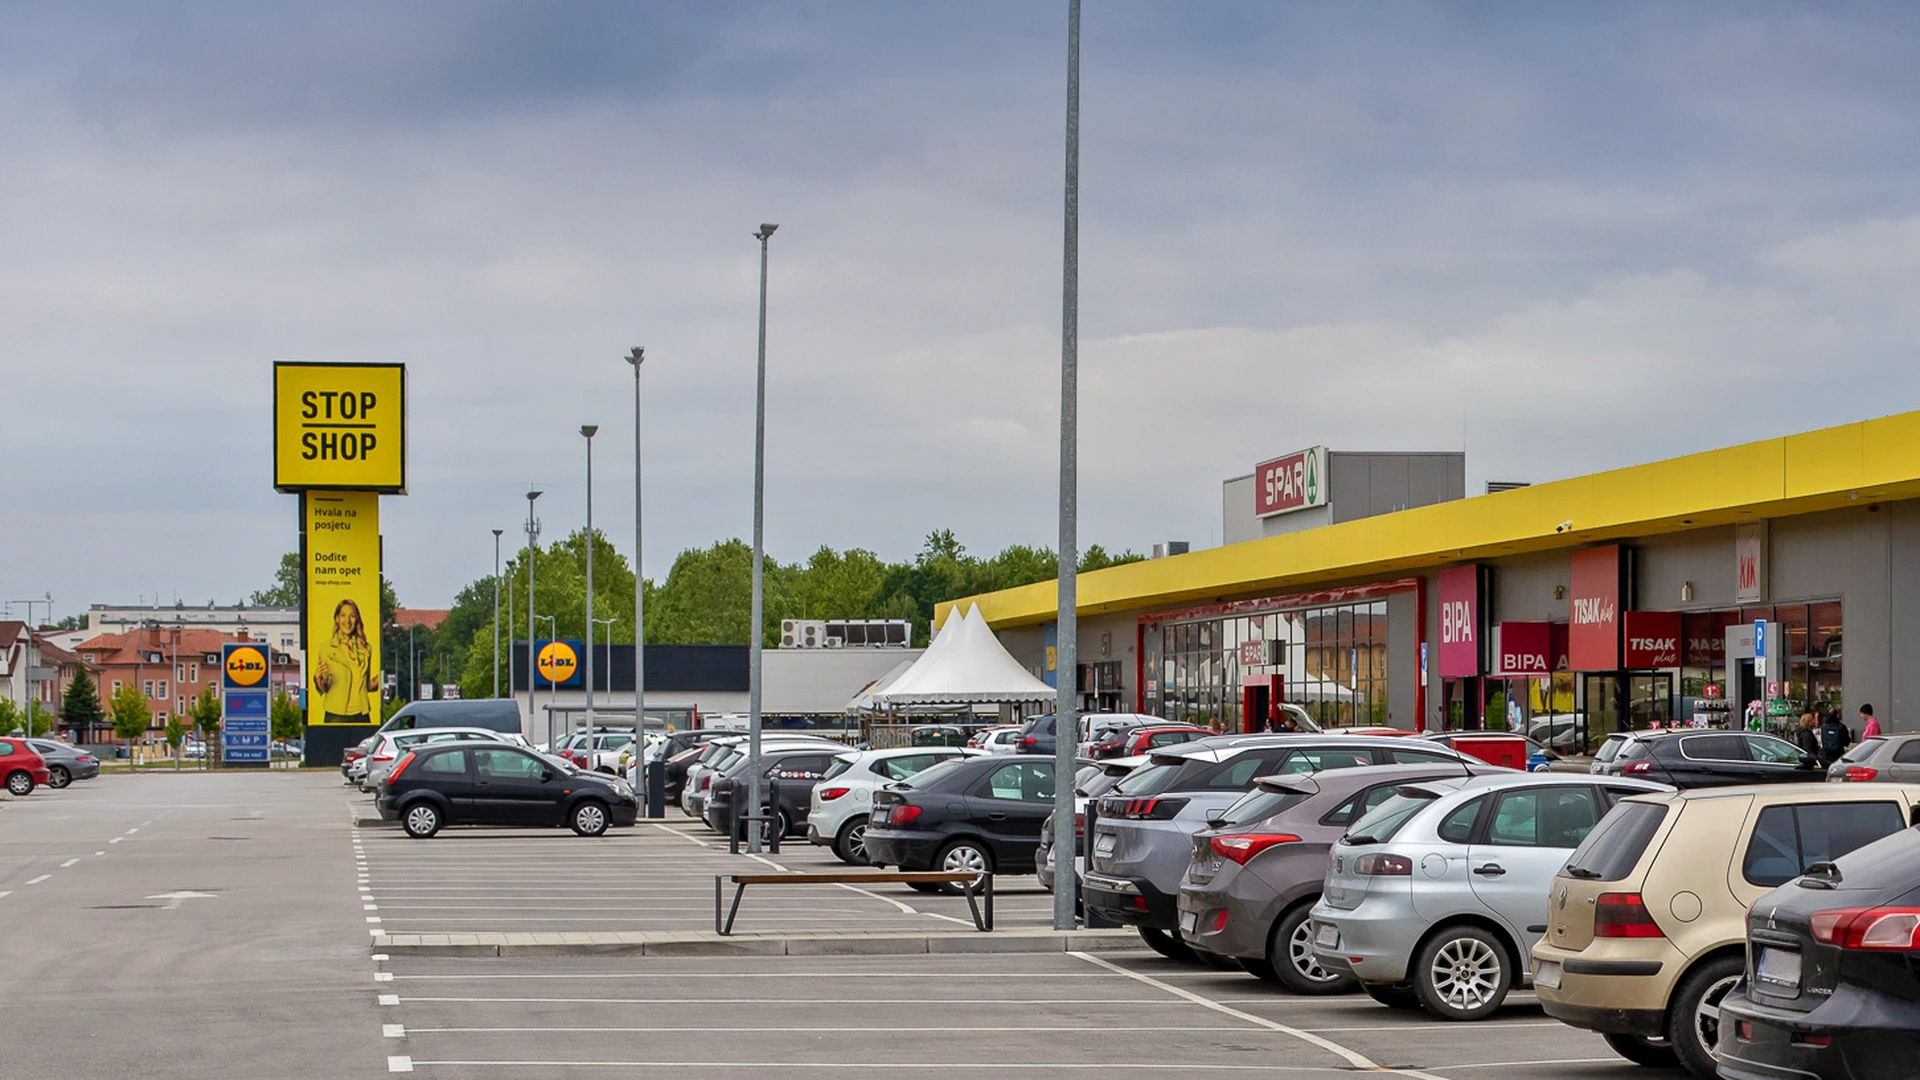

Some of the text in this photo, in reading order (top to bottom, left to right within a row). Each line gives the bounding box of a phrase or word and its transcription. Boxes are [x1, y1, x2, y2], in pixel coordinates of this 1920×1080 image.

[301, 390, 377, 420] STOP
[301, 431, 377, 461] SHOP
[1265, 461, 1304, 506] SPAR
[314, 507, 357, 517] Hvala na
[314, 520, 352, 532] posjetu
[314, 552, 348, 562] Dođite
[314, 566, 361, 577] nam opet
[1573, 596, 1614, 629] TISAK plus
[1442, 600, 1473, 643] BIPA
[1630, 638, 1677, 651] TISAK
[1756, 627, 1764, 650] P
[1244, 644, 1262, 662] SPAR
[1504, 654, 1547, 669] BIPA
[1652, 650, 1677, 666] plus
